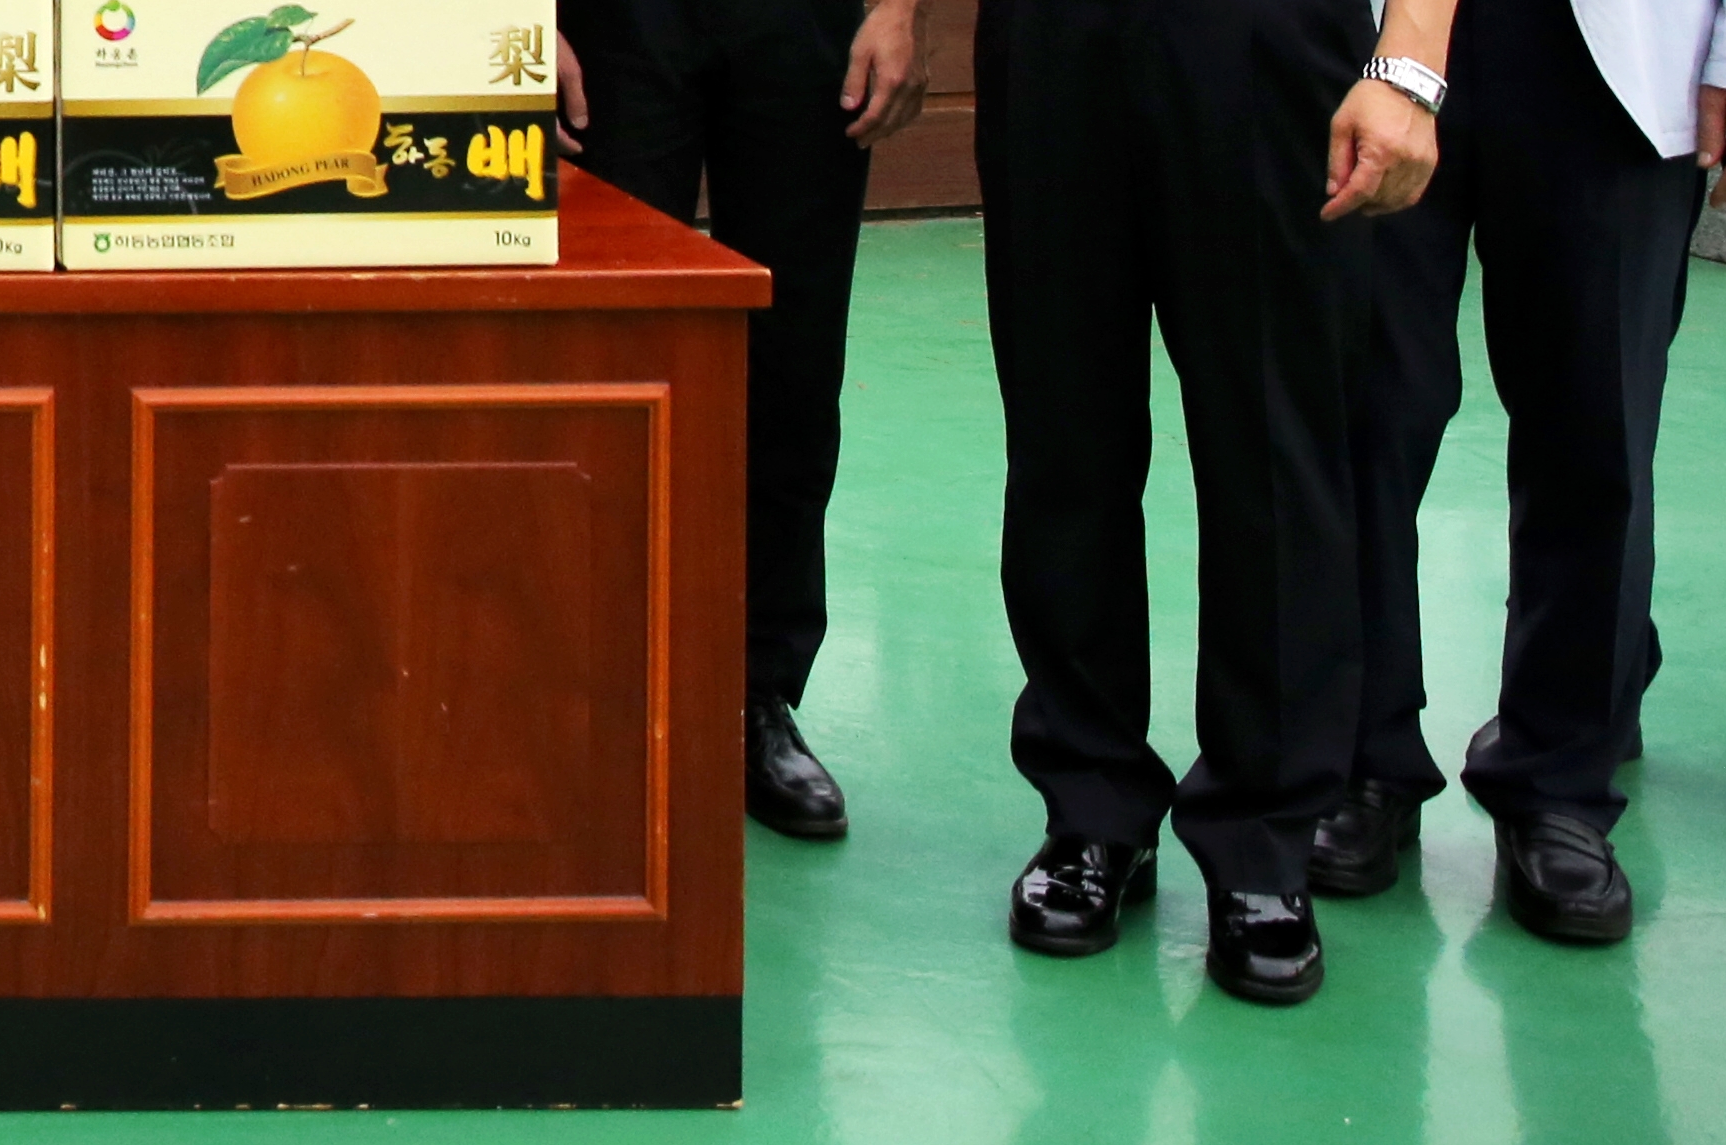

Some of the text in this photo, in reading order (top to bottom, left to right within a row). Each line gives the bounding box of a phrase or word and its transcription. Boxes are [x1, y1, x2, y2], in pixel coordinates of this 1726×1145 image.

[489, 23, 546, 86] 梨
[251, 157, 350, 187] HADONG PEAR
[467, 123, 544, 201] 배
[114, 234, 235, 249] 하동농업협동조합
[495, 230, 531, 248] 10Kg
